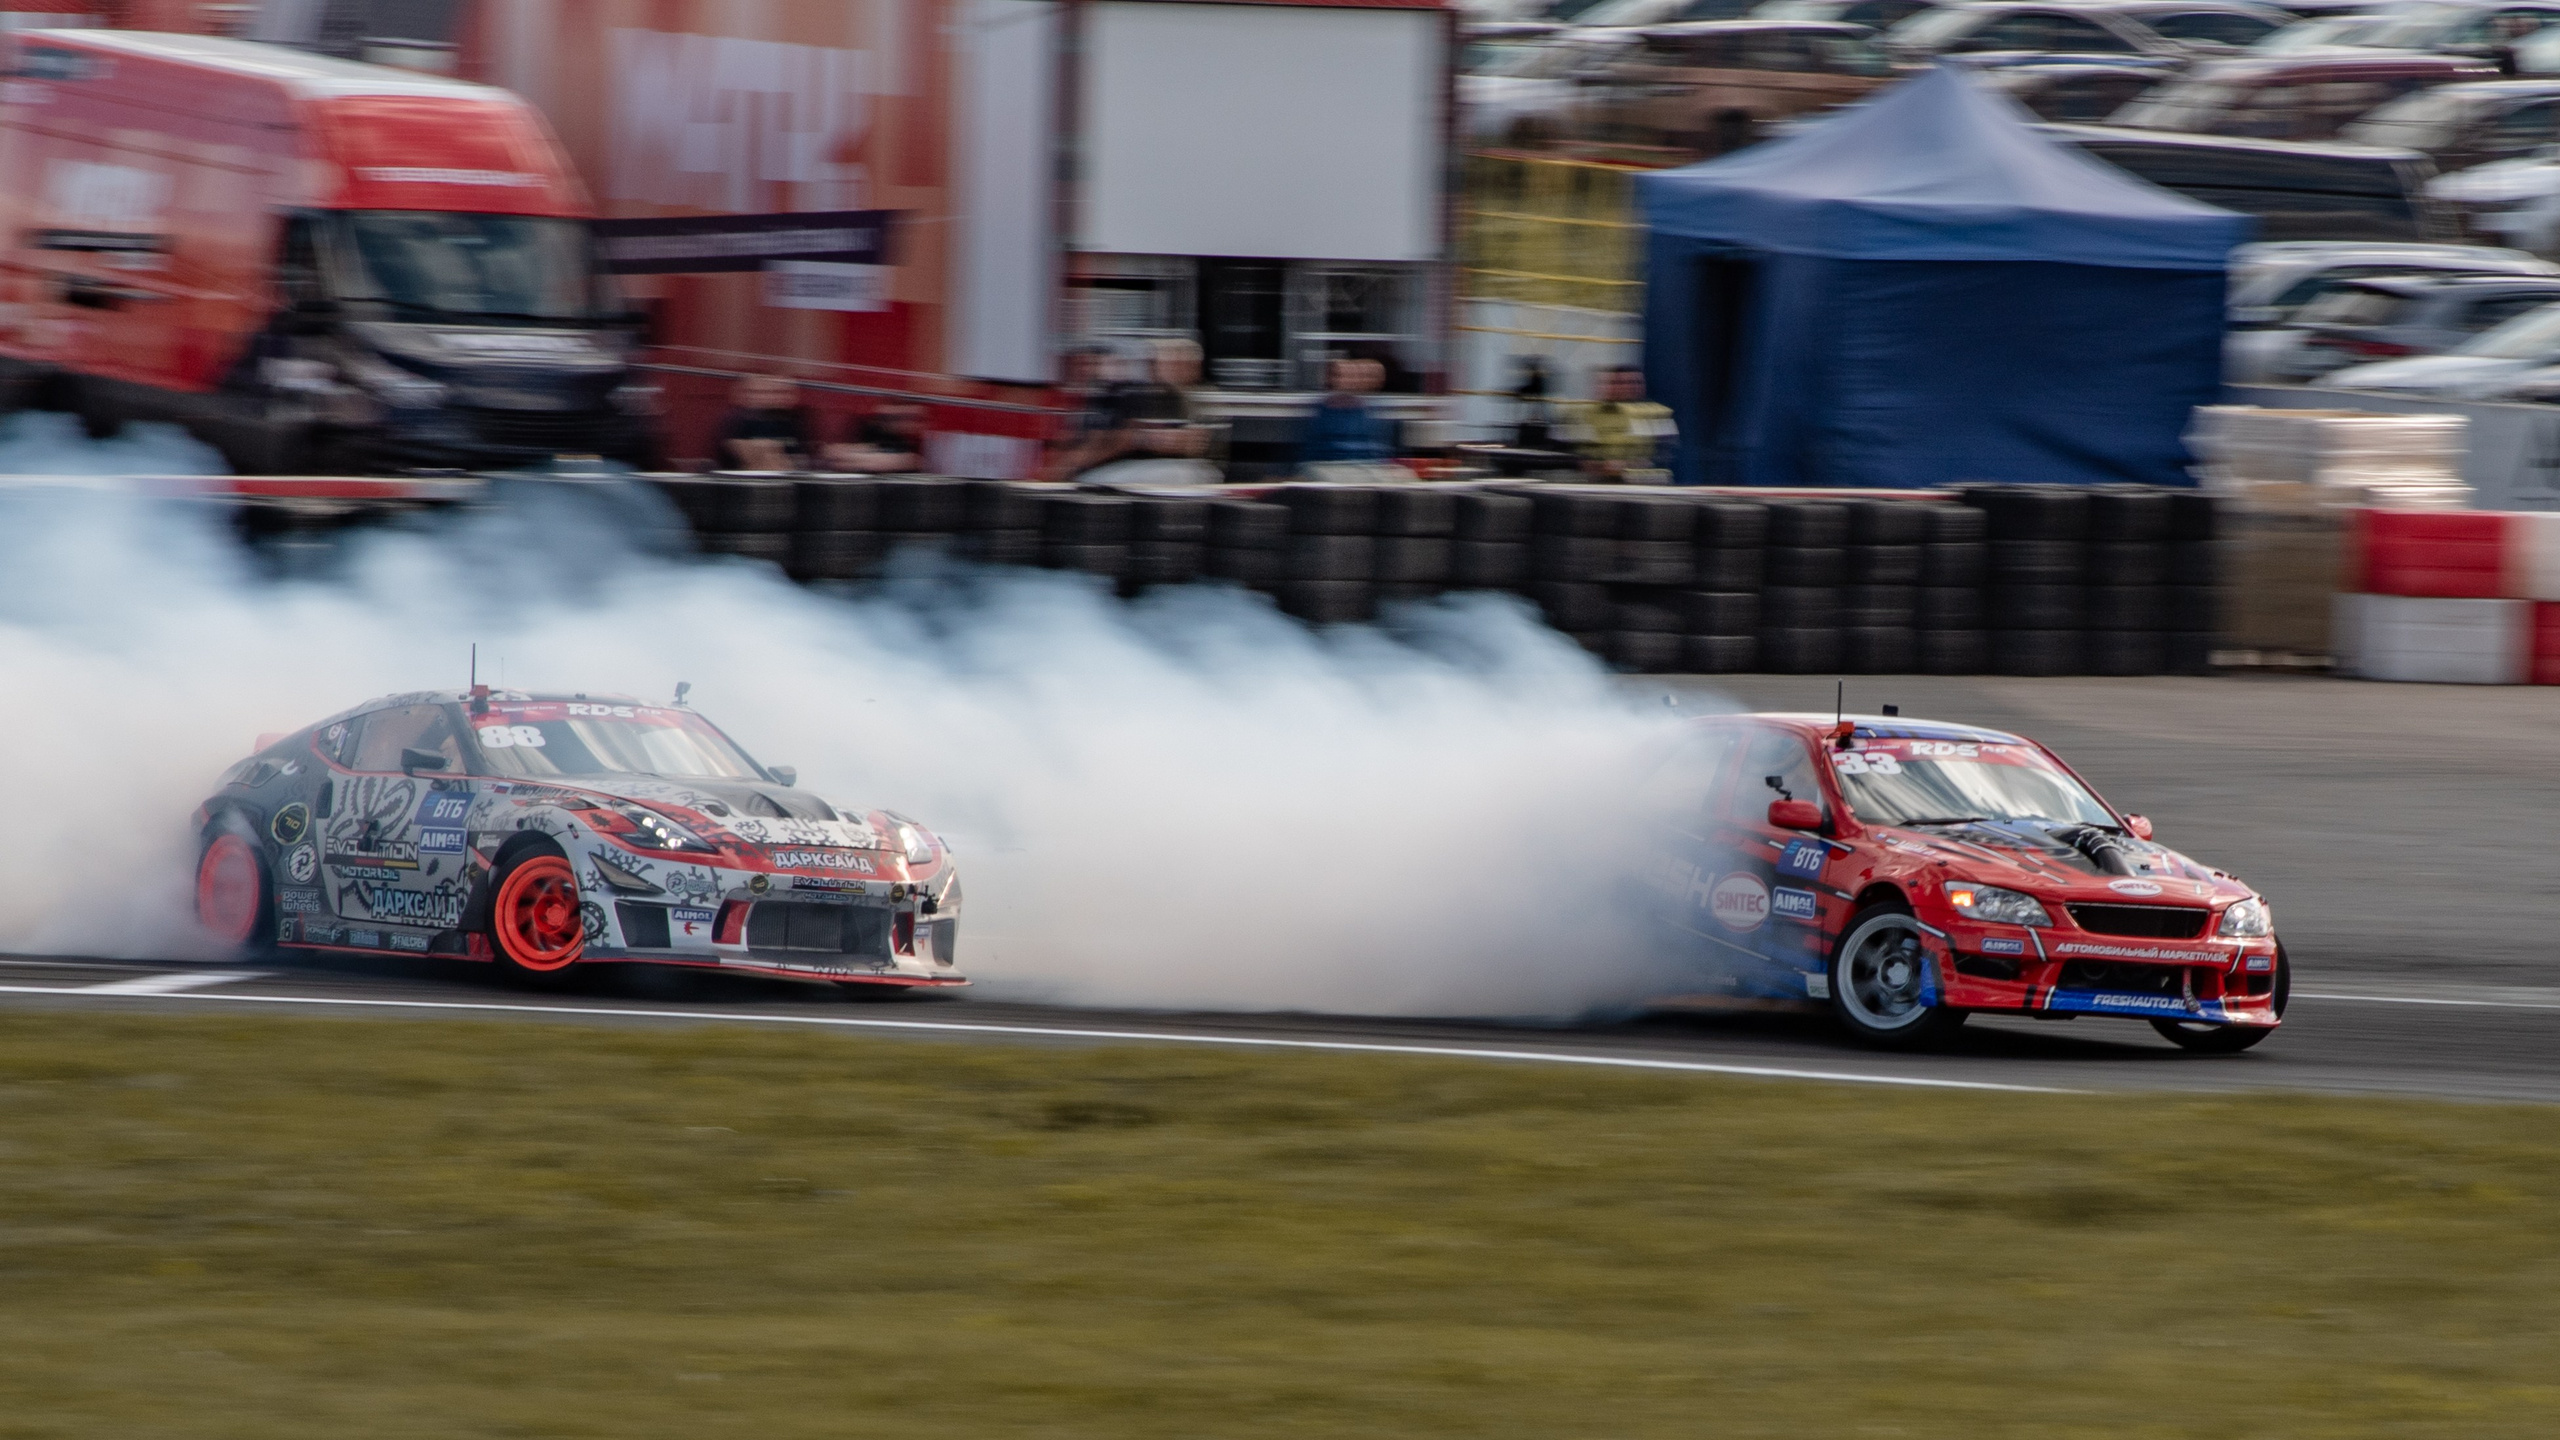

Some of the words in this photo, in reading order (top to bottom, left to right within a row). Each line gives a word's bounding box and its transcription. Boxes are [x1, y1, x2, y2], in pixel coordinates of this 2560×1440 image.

[566, 703, 635, 718] RDS
[478, 725, 546, 748] 88
[1910, 742, 1979, 758] RDS
[1832, 752, 1902, 775] 33
[433, 799, 467, 818] ВТБ
[420, 832, 464, 849] AIMOL
[774, 851, 875, 874] ДАРКСАЙД
[1793, 847, 1824, 871] ВТБ
[793, 877, 866, 889] EVOLUTION
[371, 886, 460, 924] ДАРКСАЙД
[1715, 890, 1766, 913] SINTEC
[1775, 892, 1814, 912] AIMOL
[674, 910, 712, 922] AIMOL
[2056, 942, 2159, 958] АВТОМОБИЛЬНЫЙ
[2159, 949, 2230, 963] МАРКЕТПЛЕЙС
